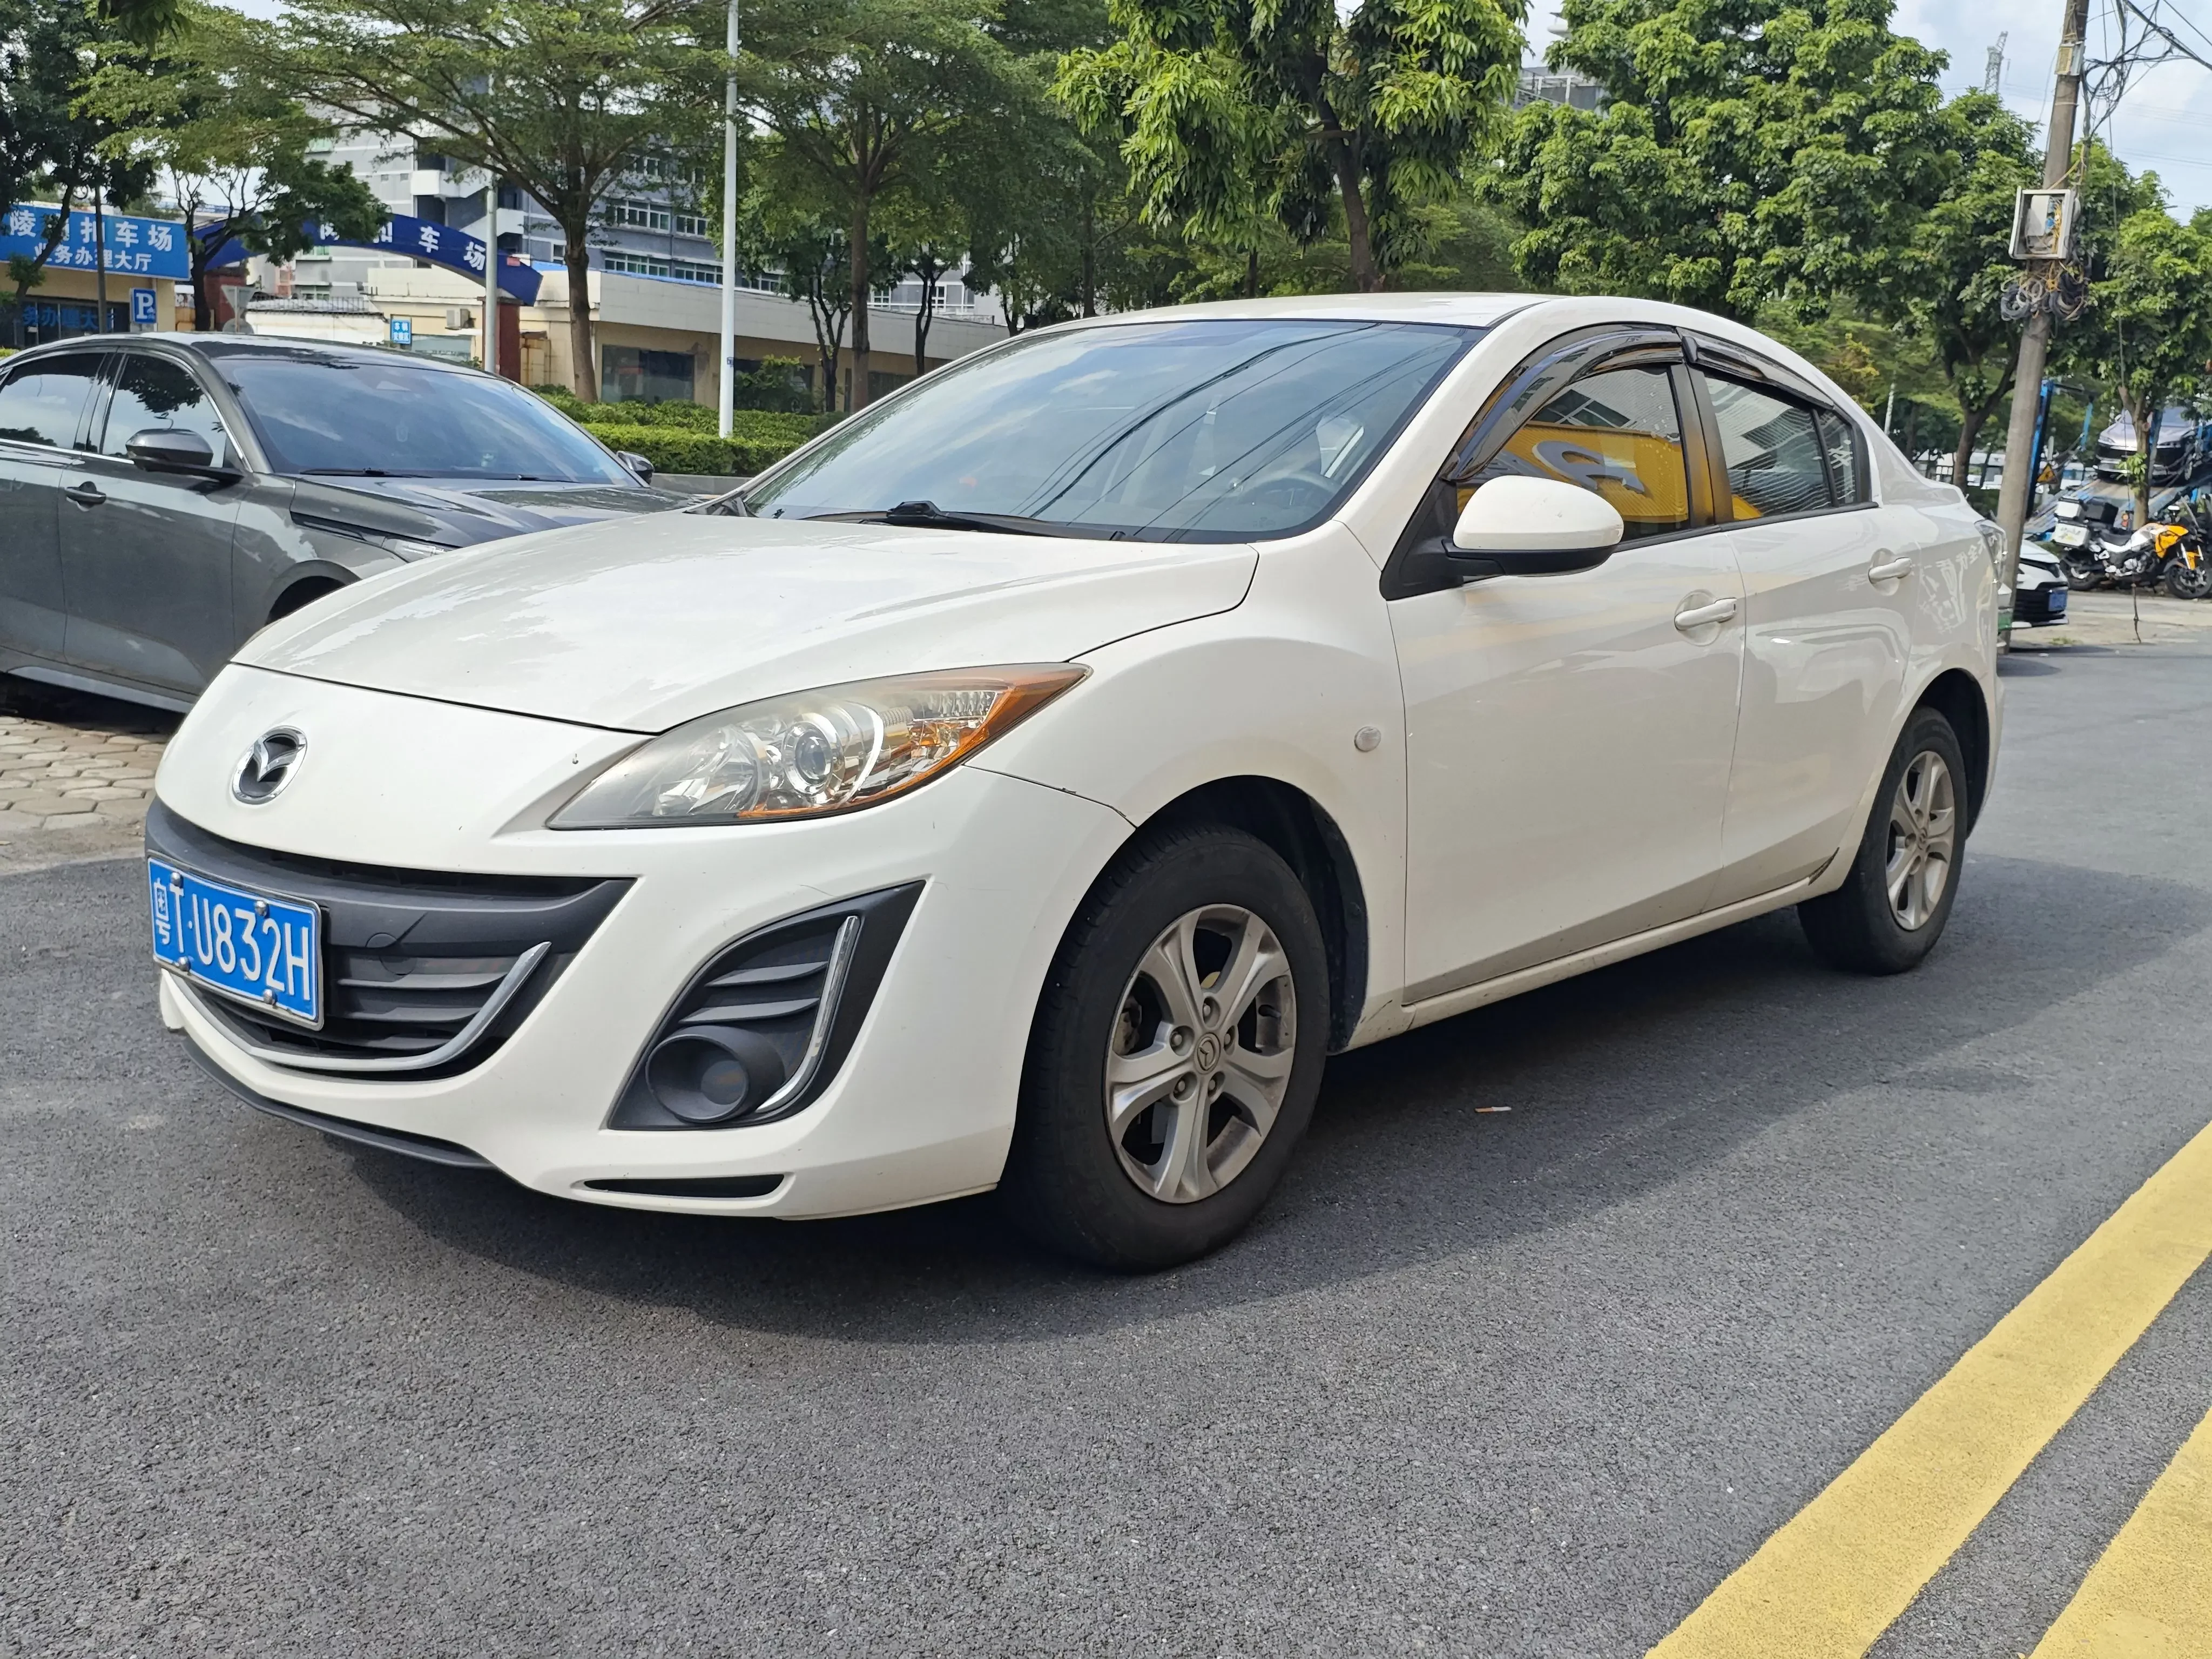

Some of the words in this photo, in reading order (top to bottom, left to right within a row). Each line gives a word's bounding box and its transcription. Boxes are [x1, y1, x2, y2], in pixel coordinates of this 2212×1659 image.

[10, 210, 173, 252] 陵扣车场
[136, 292, 154, 320] P
